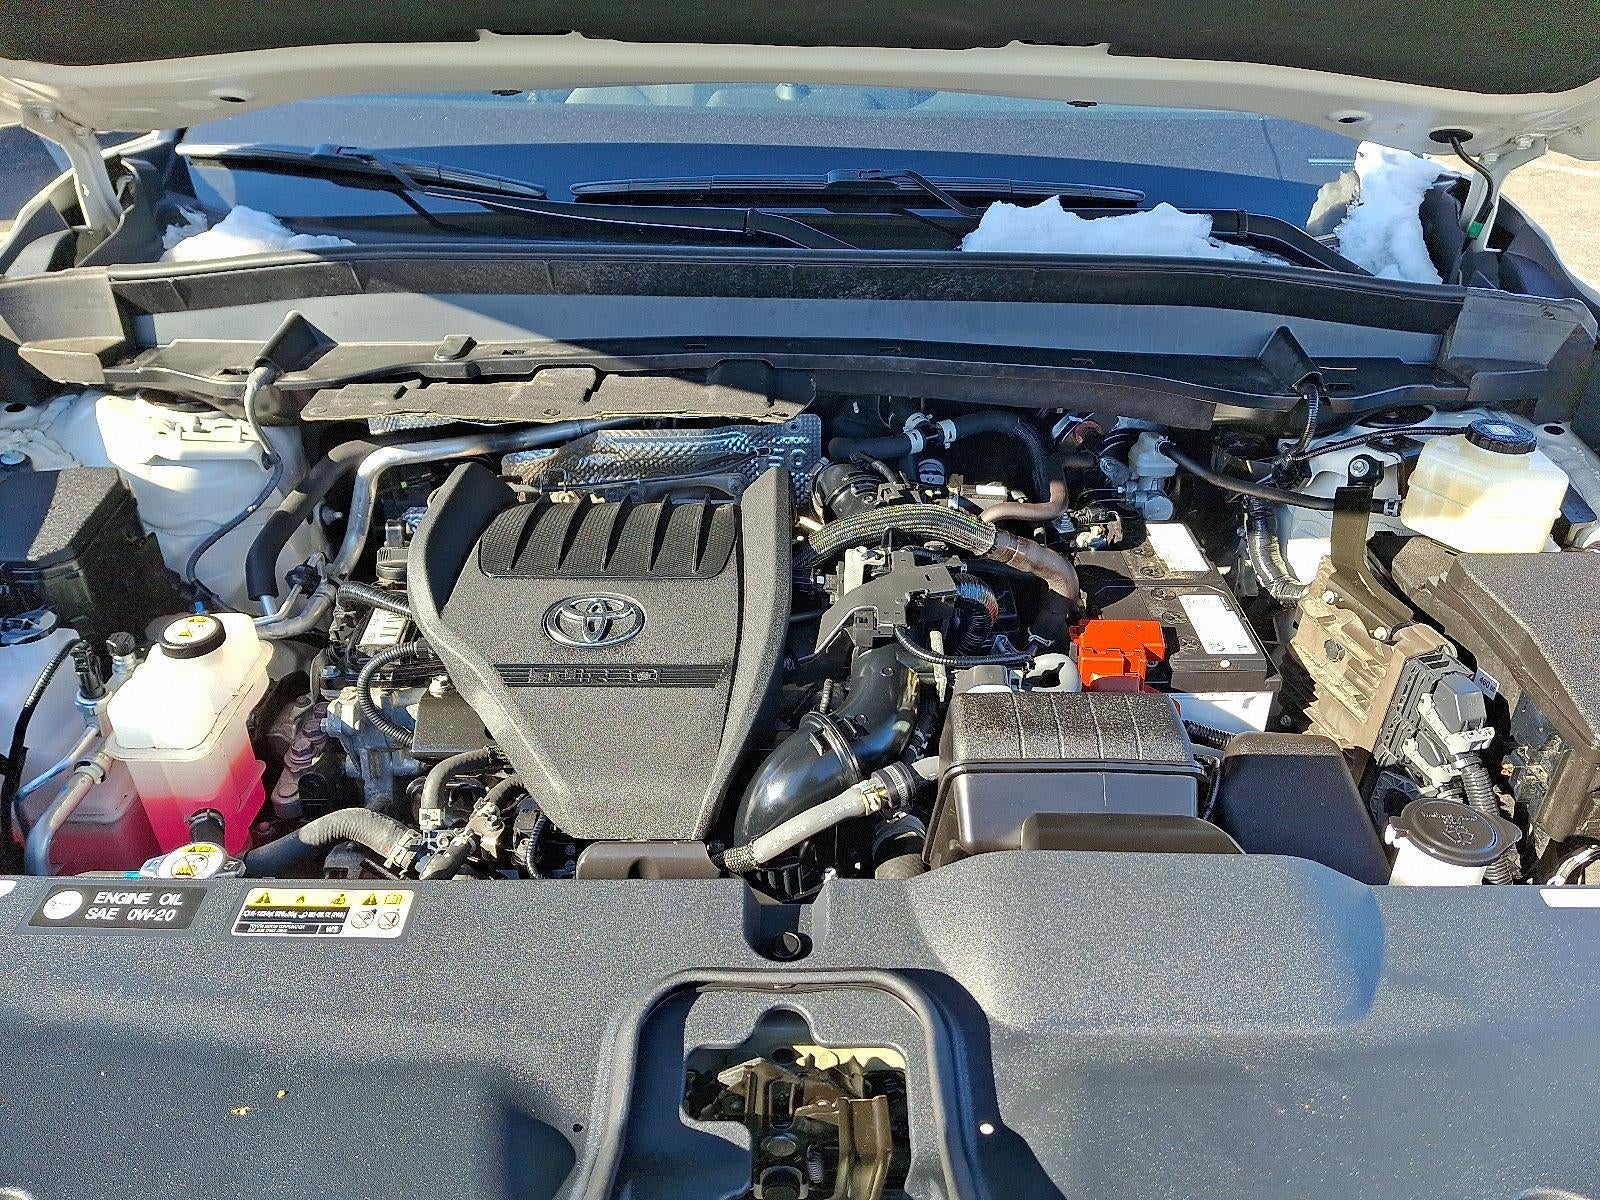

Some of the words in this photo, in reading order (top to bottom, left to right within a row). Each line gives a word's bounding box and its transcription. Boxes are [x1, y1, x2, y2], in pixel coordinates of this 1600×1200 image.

[93, 891, 153, 905] ENGINE
[158, 892, 184, 906] OIL
[84, 907, 121, 921] SAE
[126, 908, 177, 922] 0W-20
